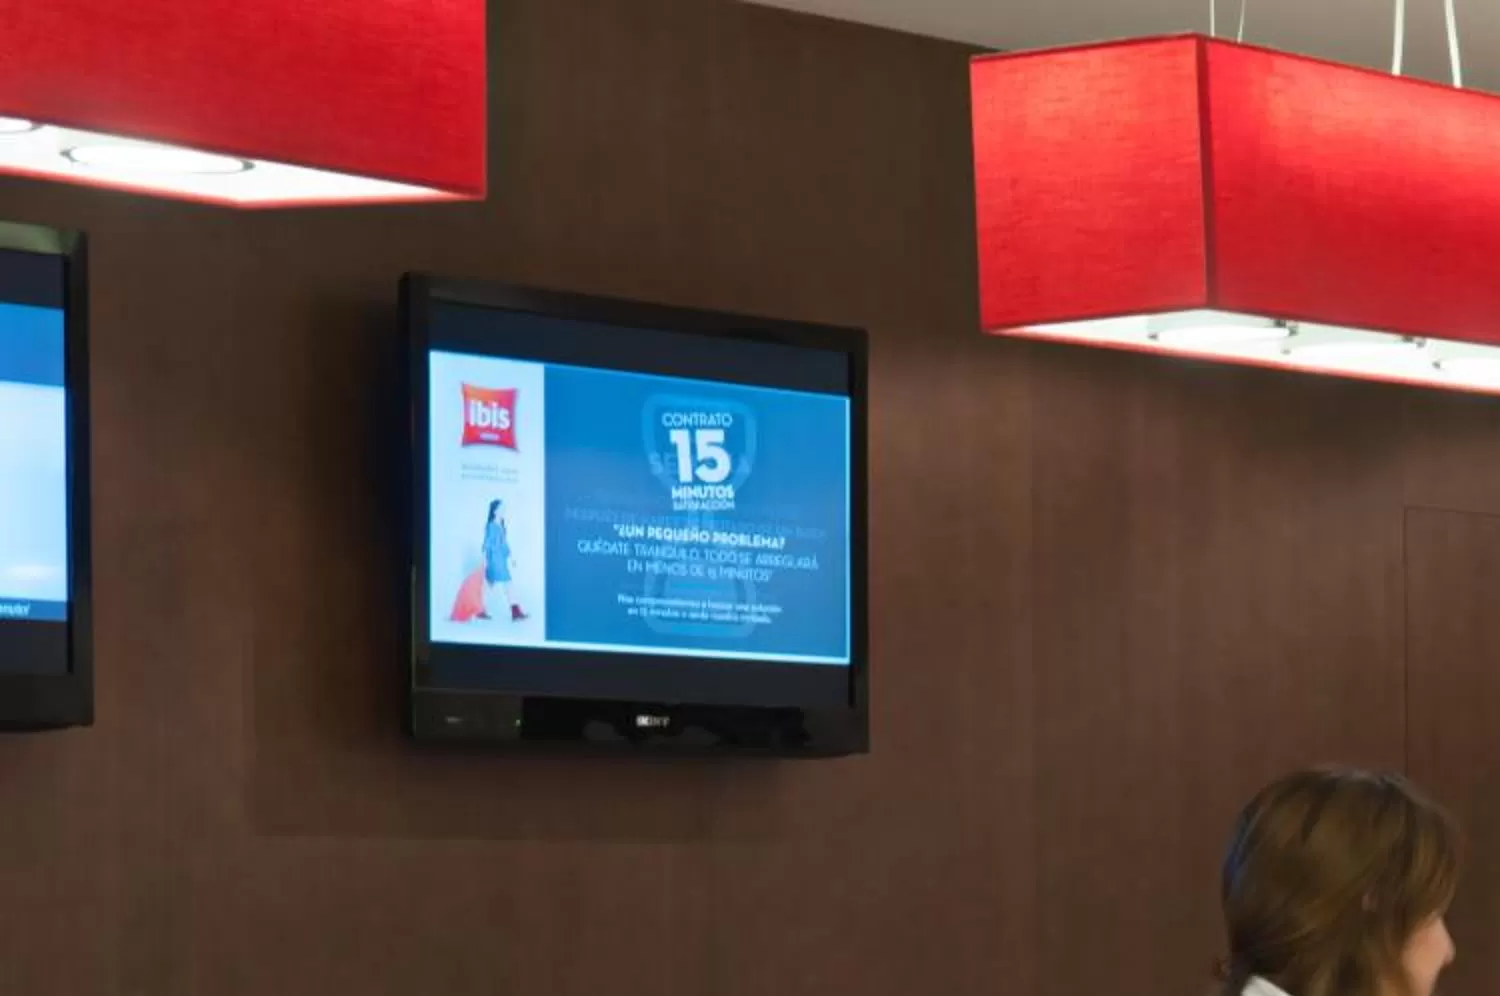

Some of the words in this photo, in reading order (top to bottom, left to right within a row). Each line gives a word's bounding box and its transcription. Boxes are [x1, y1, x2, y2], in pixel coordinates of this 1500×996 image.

[470, 400, 511, 430] ibis
[662, 412, 733, 428] CONTRATO
[670, 429, 732, 484] 15
[672, 484, 735, 499] MINUTOS
[647, 525, 711, 543] PEQUEÑO
[712, 532, 786, 550] PROBLEMA?
[577, 537, 629, 556] QUÉDATE
[704, 547, 738, 564] TODO
[645, 561, 688, 577] MENOS
